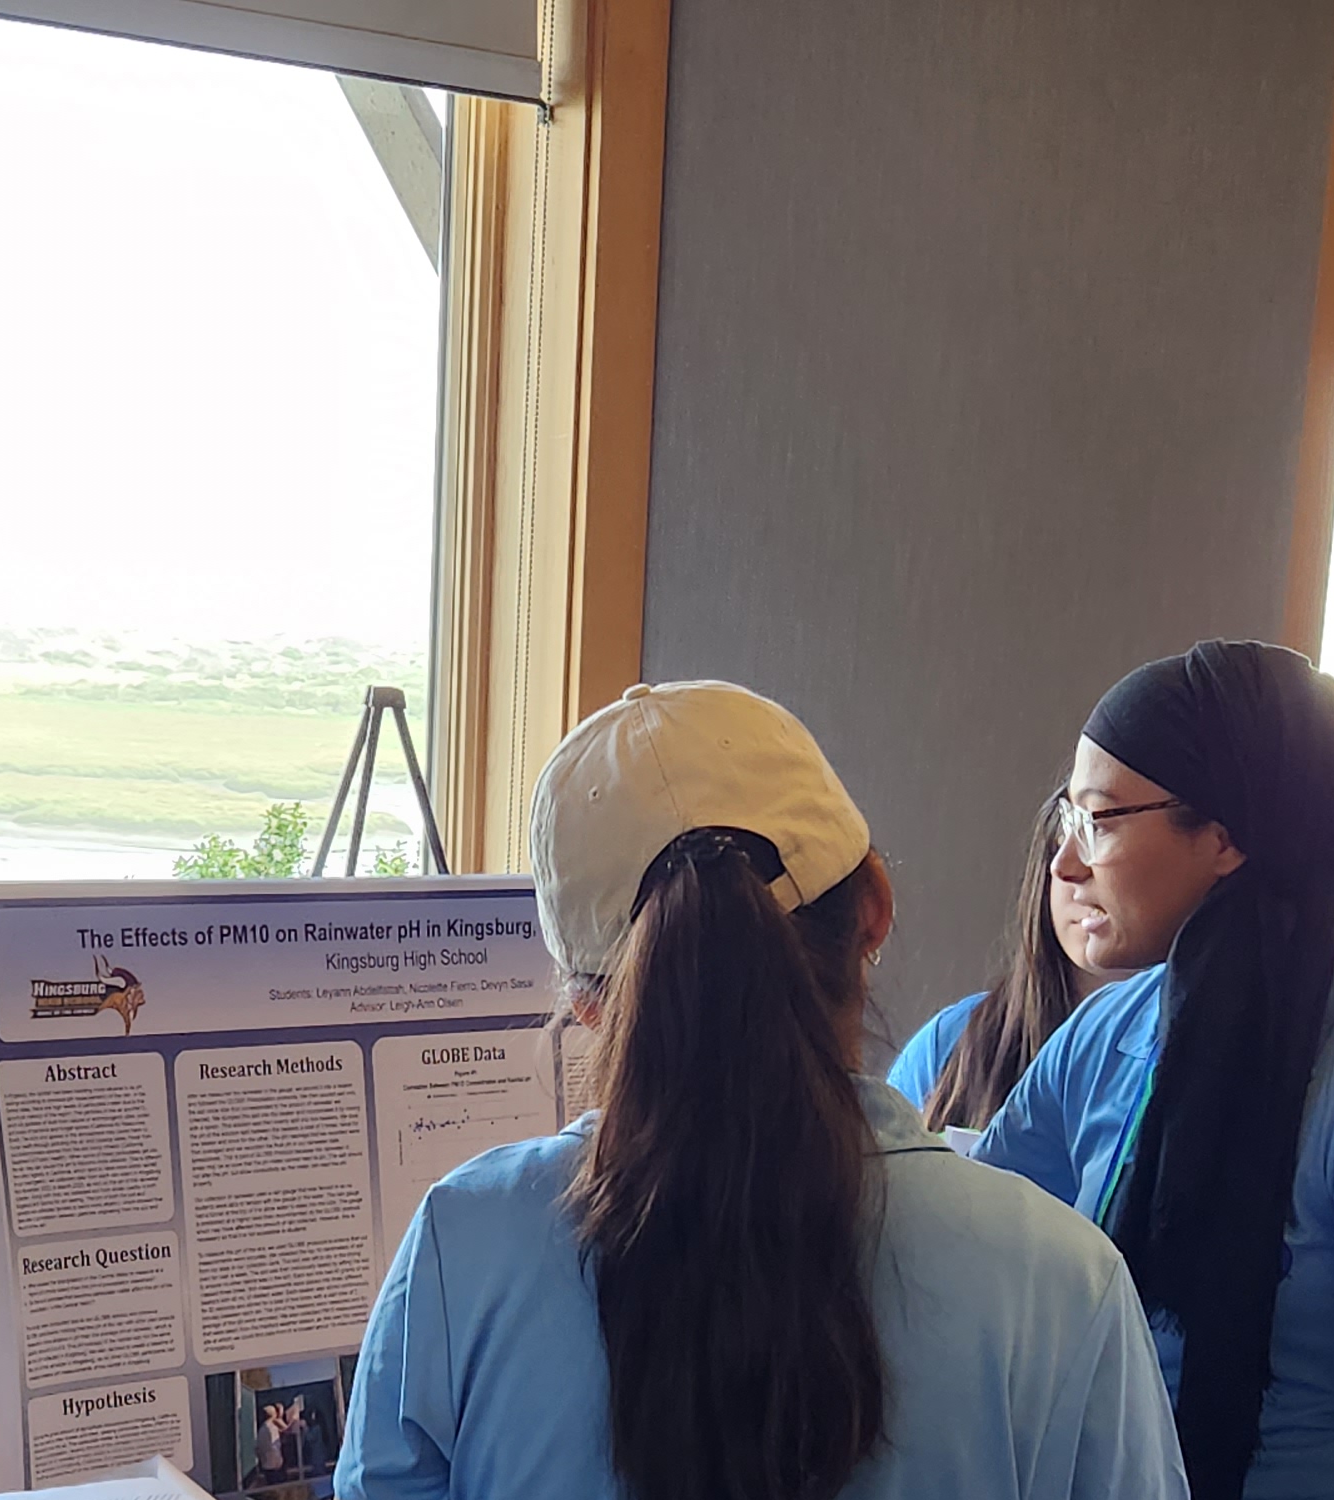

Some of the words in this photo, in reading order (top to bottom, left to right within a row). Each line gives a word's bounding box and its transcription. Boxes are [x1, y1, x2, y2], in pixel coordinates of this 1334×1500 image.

[77, 928, 115, 948] The
[121, 926, 188, 946] Effects
[195, 925, 214, 945] of
[220, 925, 269, 944] PM10
[276, 927, 298, 942] on
[305, 921, 392, 942] Rainwater
[398, 921, 420, 941] pH
[426, 920, 441, 938] in
[448, 918, 536, 940] Kingsburg,
[326, 953, 399, 972] Kingsburg
[404, 951, 436, 970] High
[442, 949, 487, 966] School
[200, 1060, 272, 1079] Research
[277, 1055, 343, 1074] Methods
[422, 1047, 469, 1064] GLOBE
[474, 1046, 506, 1061] Data
[45, 1063, 117, 1082] Abstract
[23, 1250, 90, 1275] Research
[96, 1244, 171, 1268] Question
[62, 1387, 156, 1417] Hypothesis
